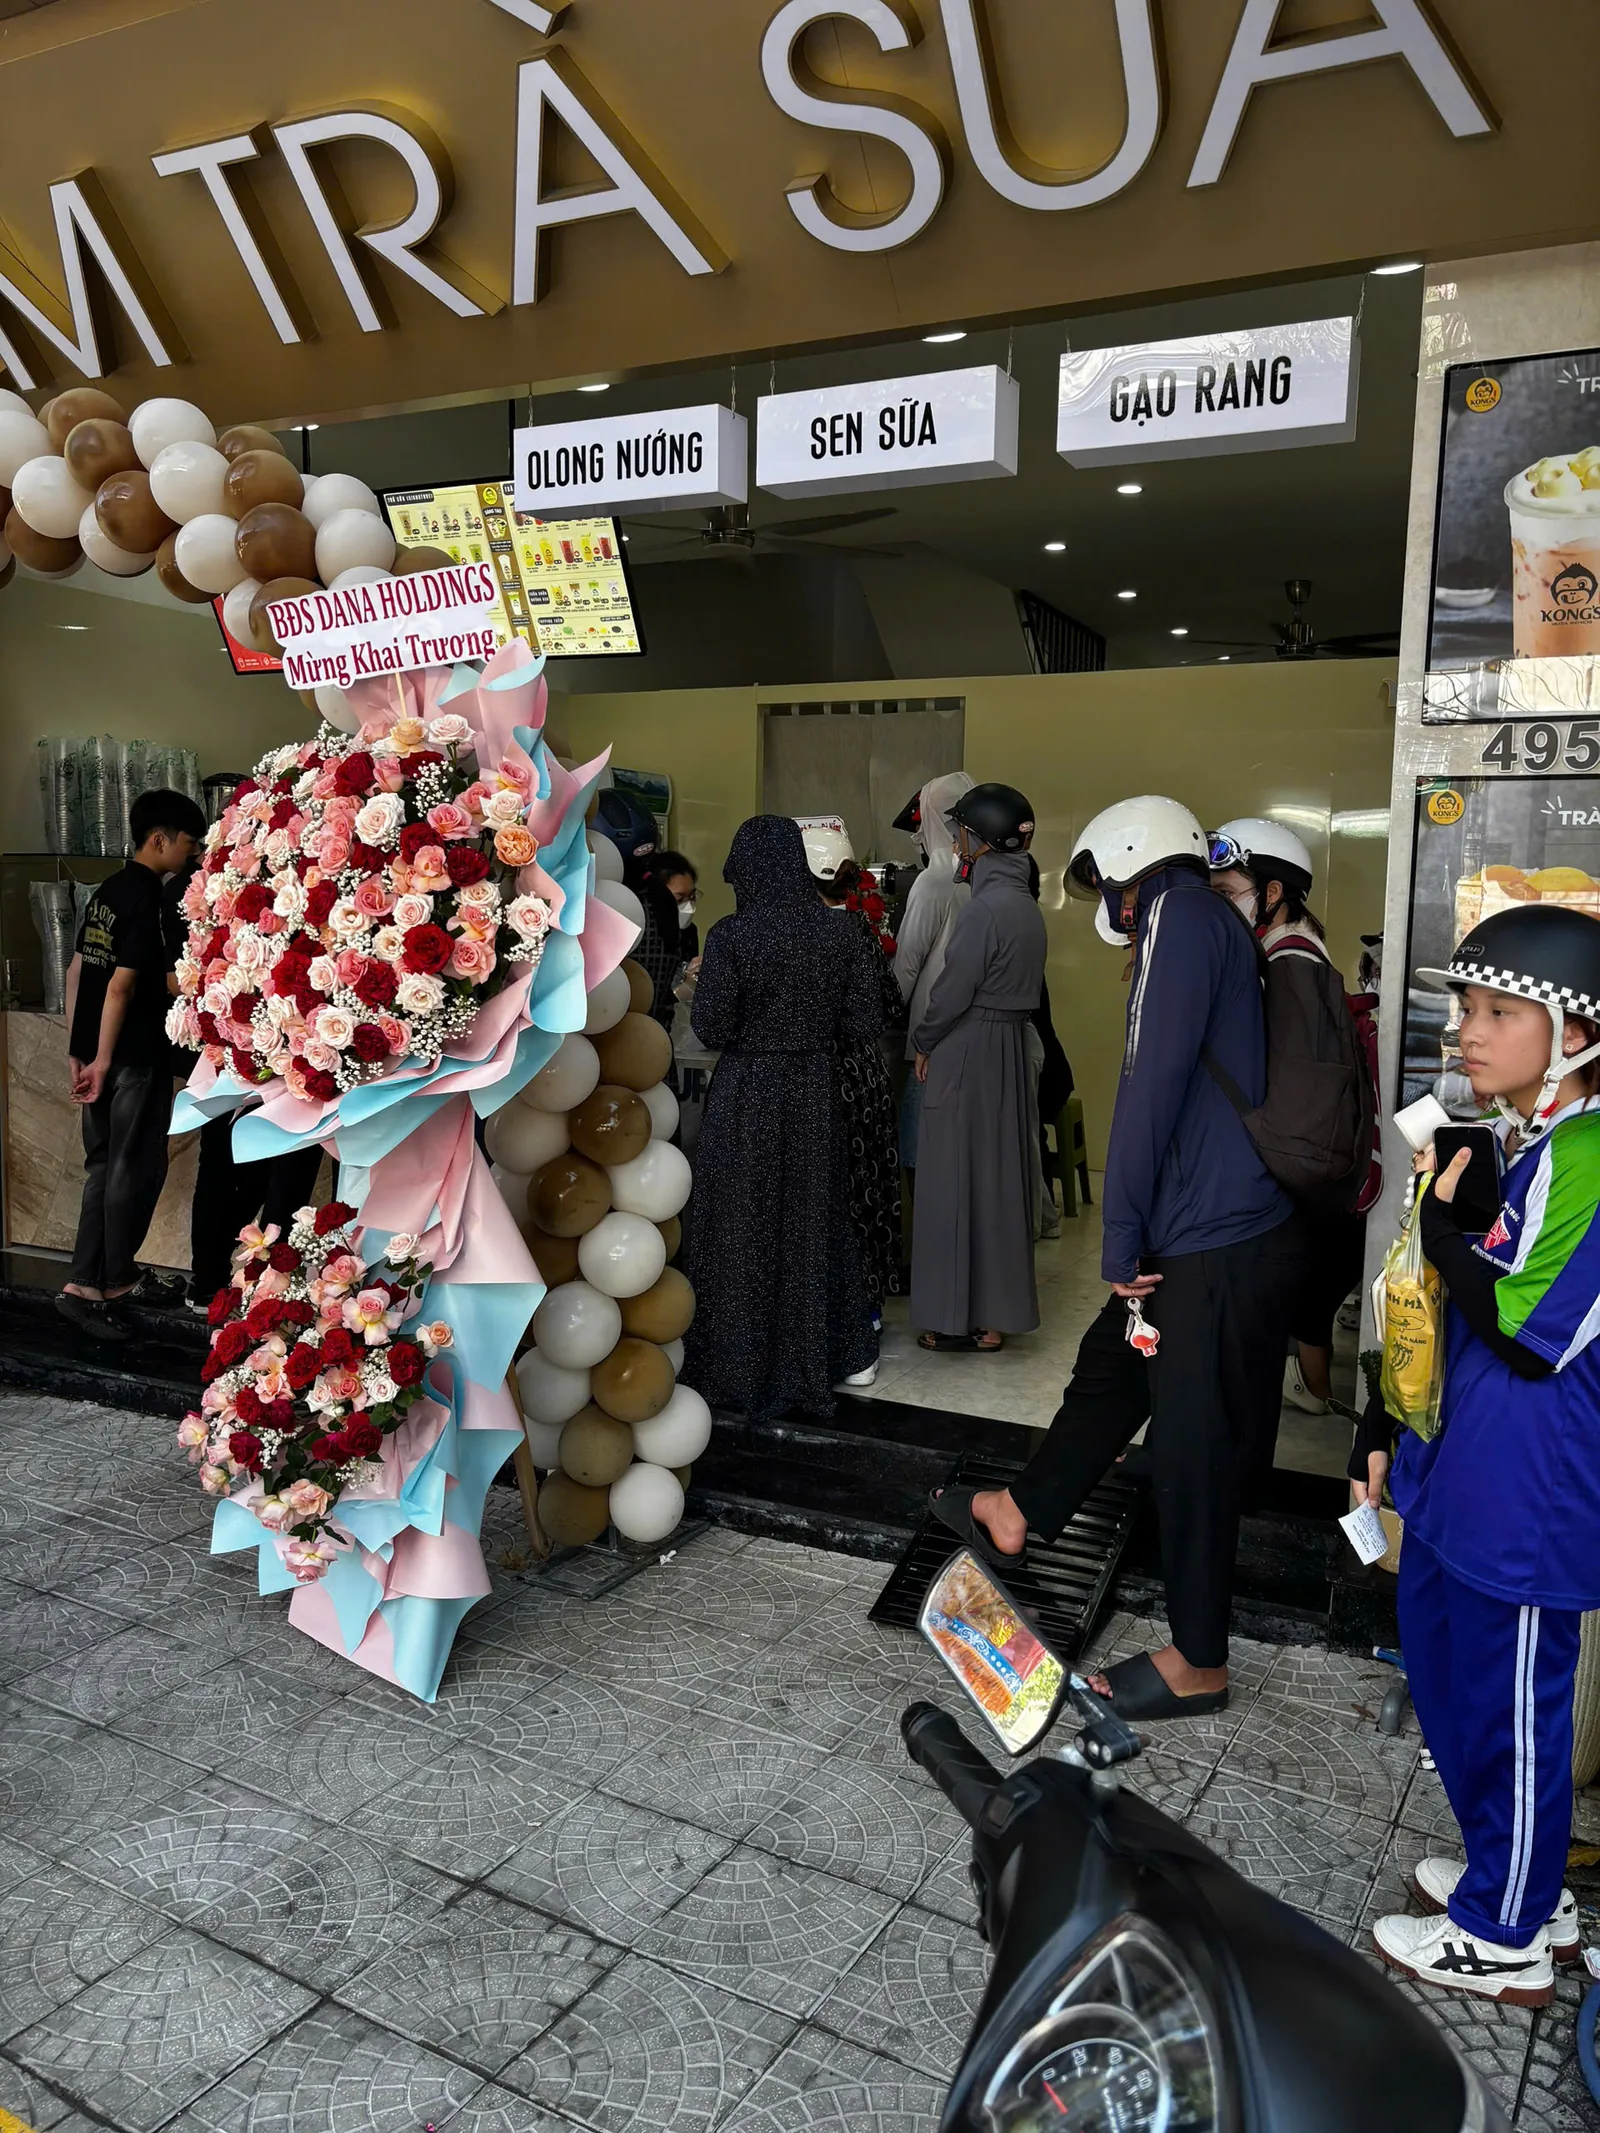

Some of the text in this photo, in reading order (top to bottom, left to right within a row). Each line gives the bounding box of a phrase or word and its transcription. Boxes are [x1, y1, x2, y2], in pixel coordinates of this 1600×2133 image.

[152, 0, 713, 344] TRÀ
[1109, 355, 1292, 427] GẠO RANG
[527, 428, 702, 490] OLONG NƯỚNG
[810, 397, 938, 461] SEN SỮA
[269, 563, 495, 639] BĐS DANA HOLDINGS
[287, 630, 496, 687] Mừng Khai Trương
[1480, 721, 1600, 773] 495
